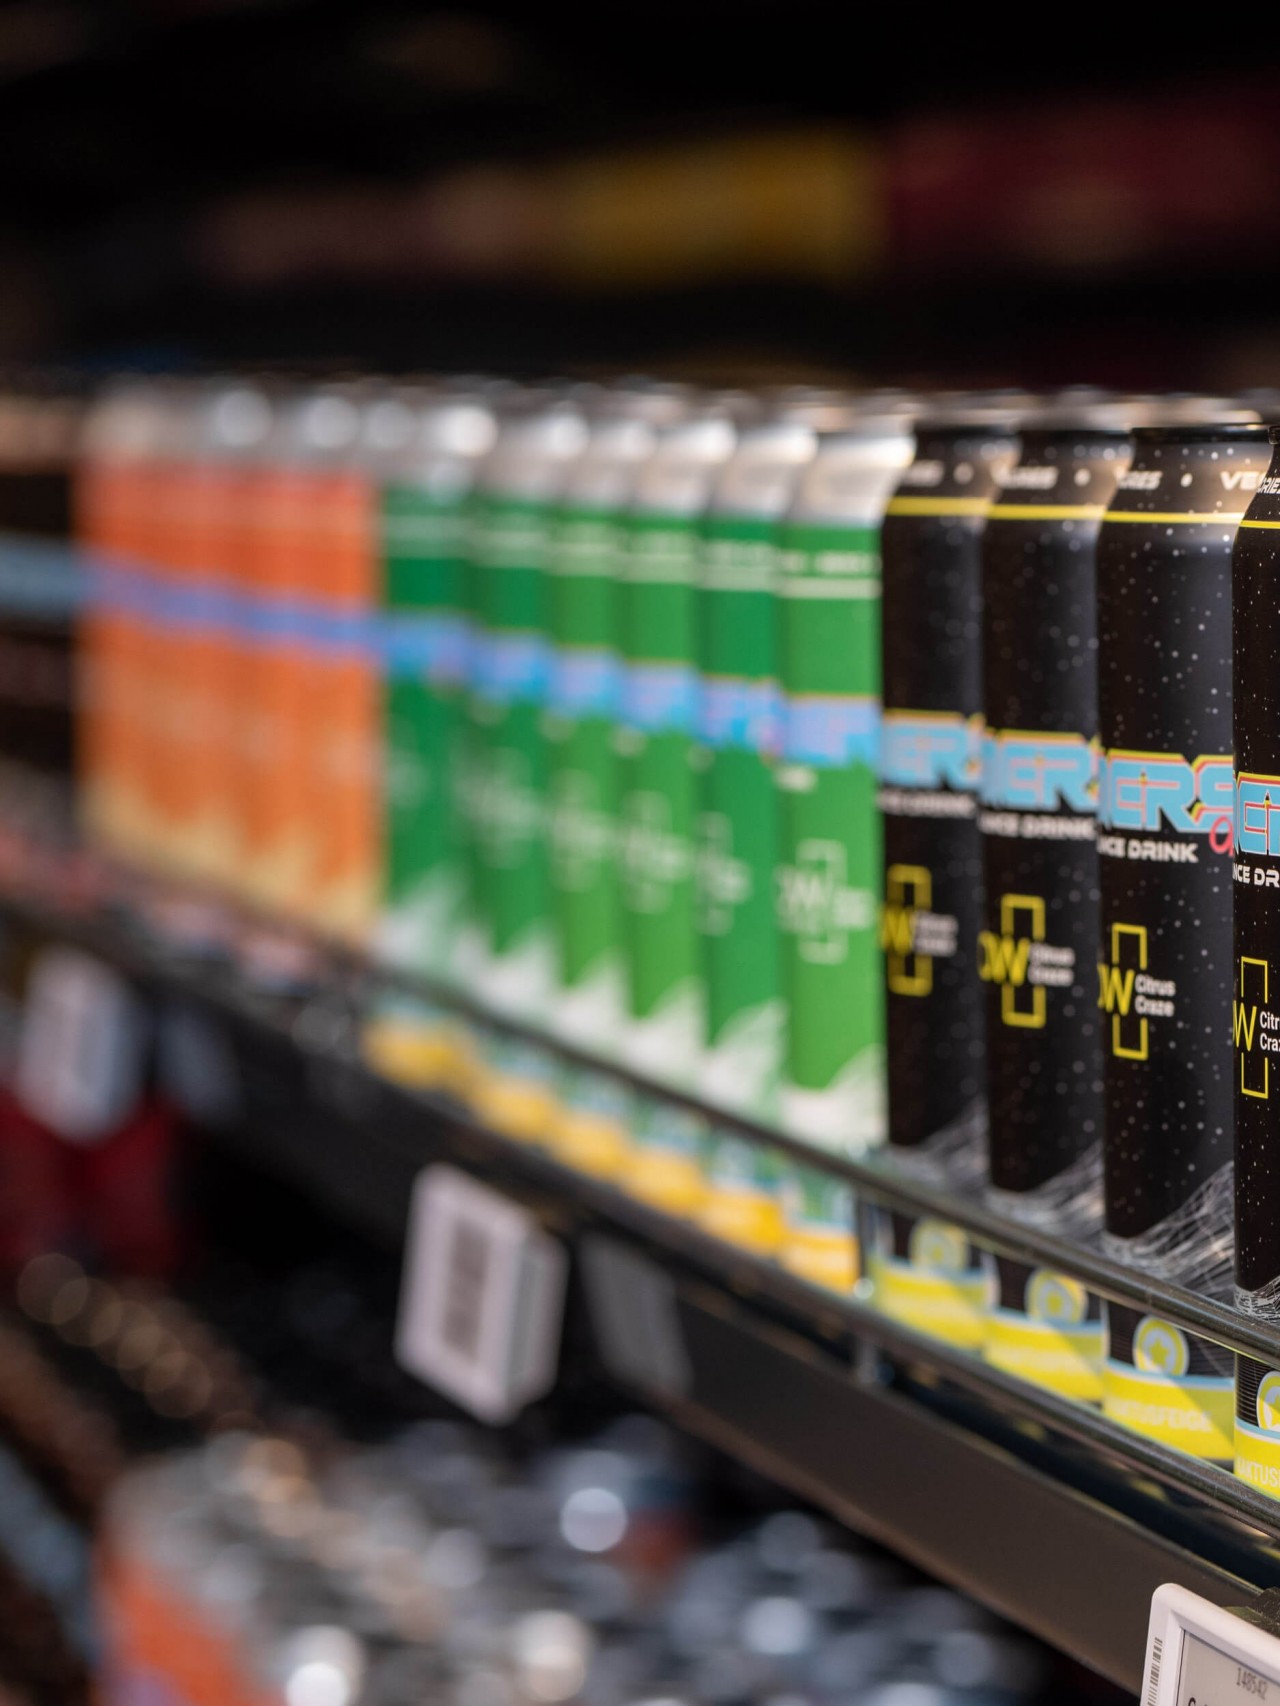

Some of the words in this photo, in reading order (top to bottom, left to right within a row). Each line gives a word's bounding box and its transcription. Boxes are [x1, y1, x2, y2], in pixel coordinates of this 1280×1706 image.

[1126, 838, 1199, 863] DRINK
[1135, 974, 1177, 997] Citrus
[1135, 995, 1176, 1018] Craze
